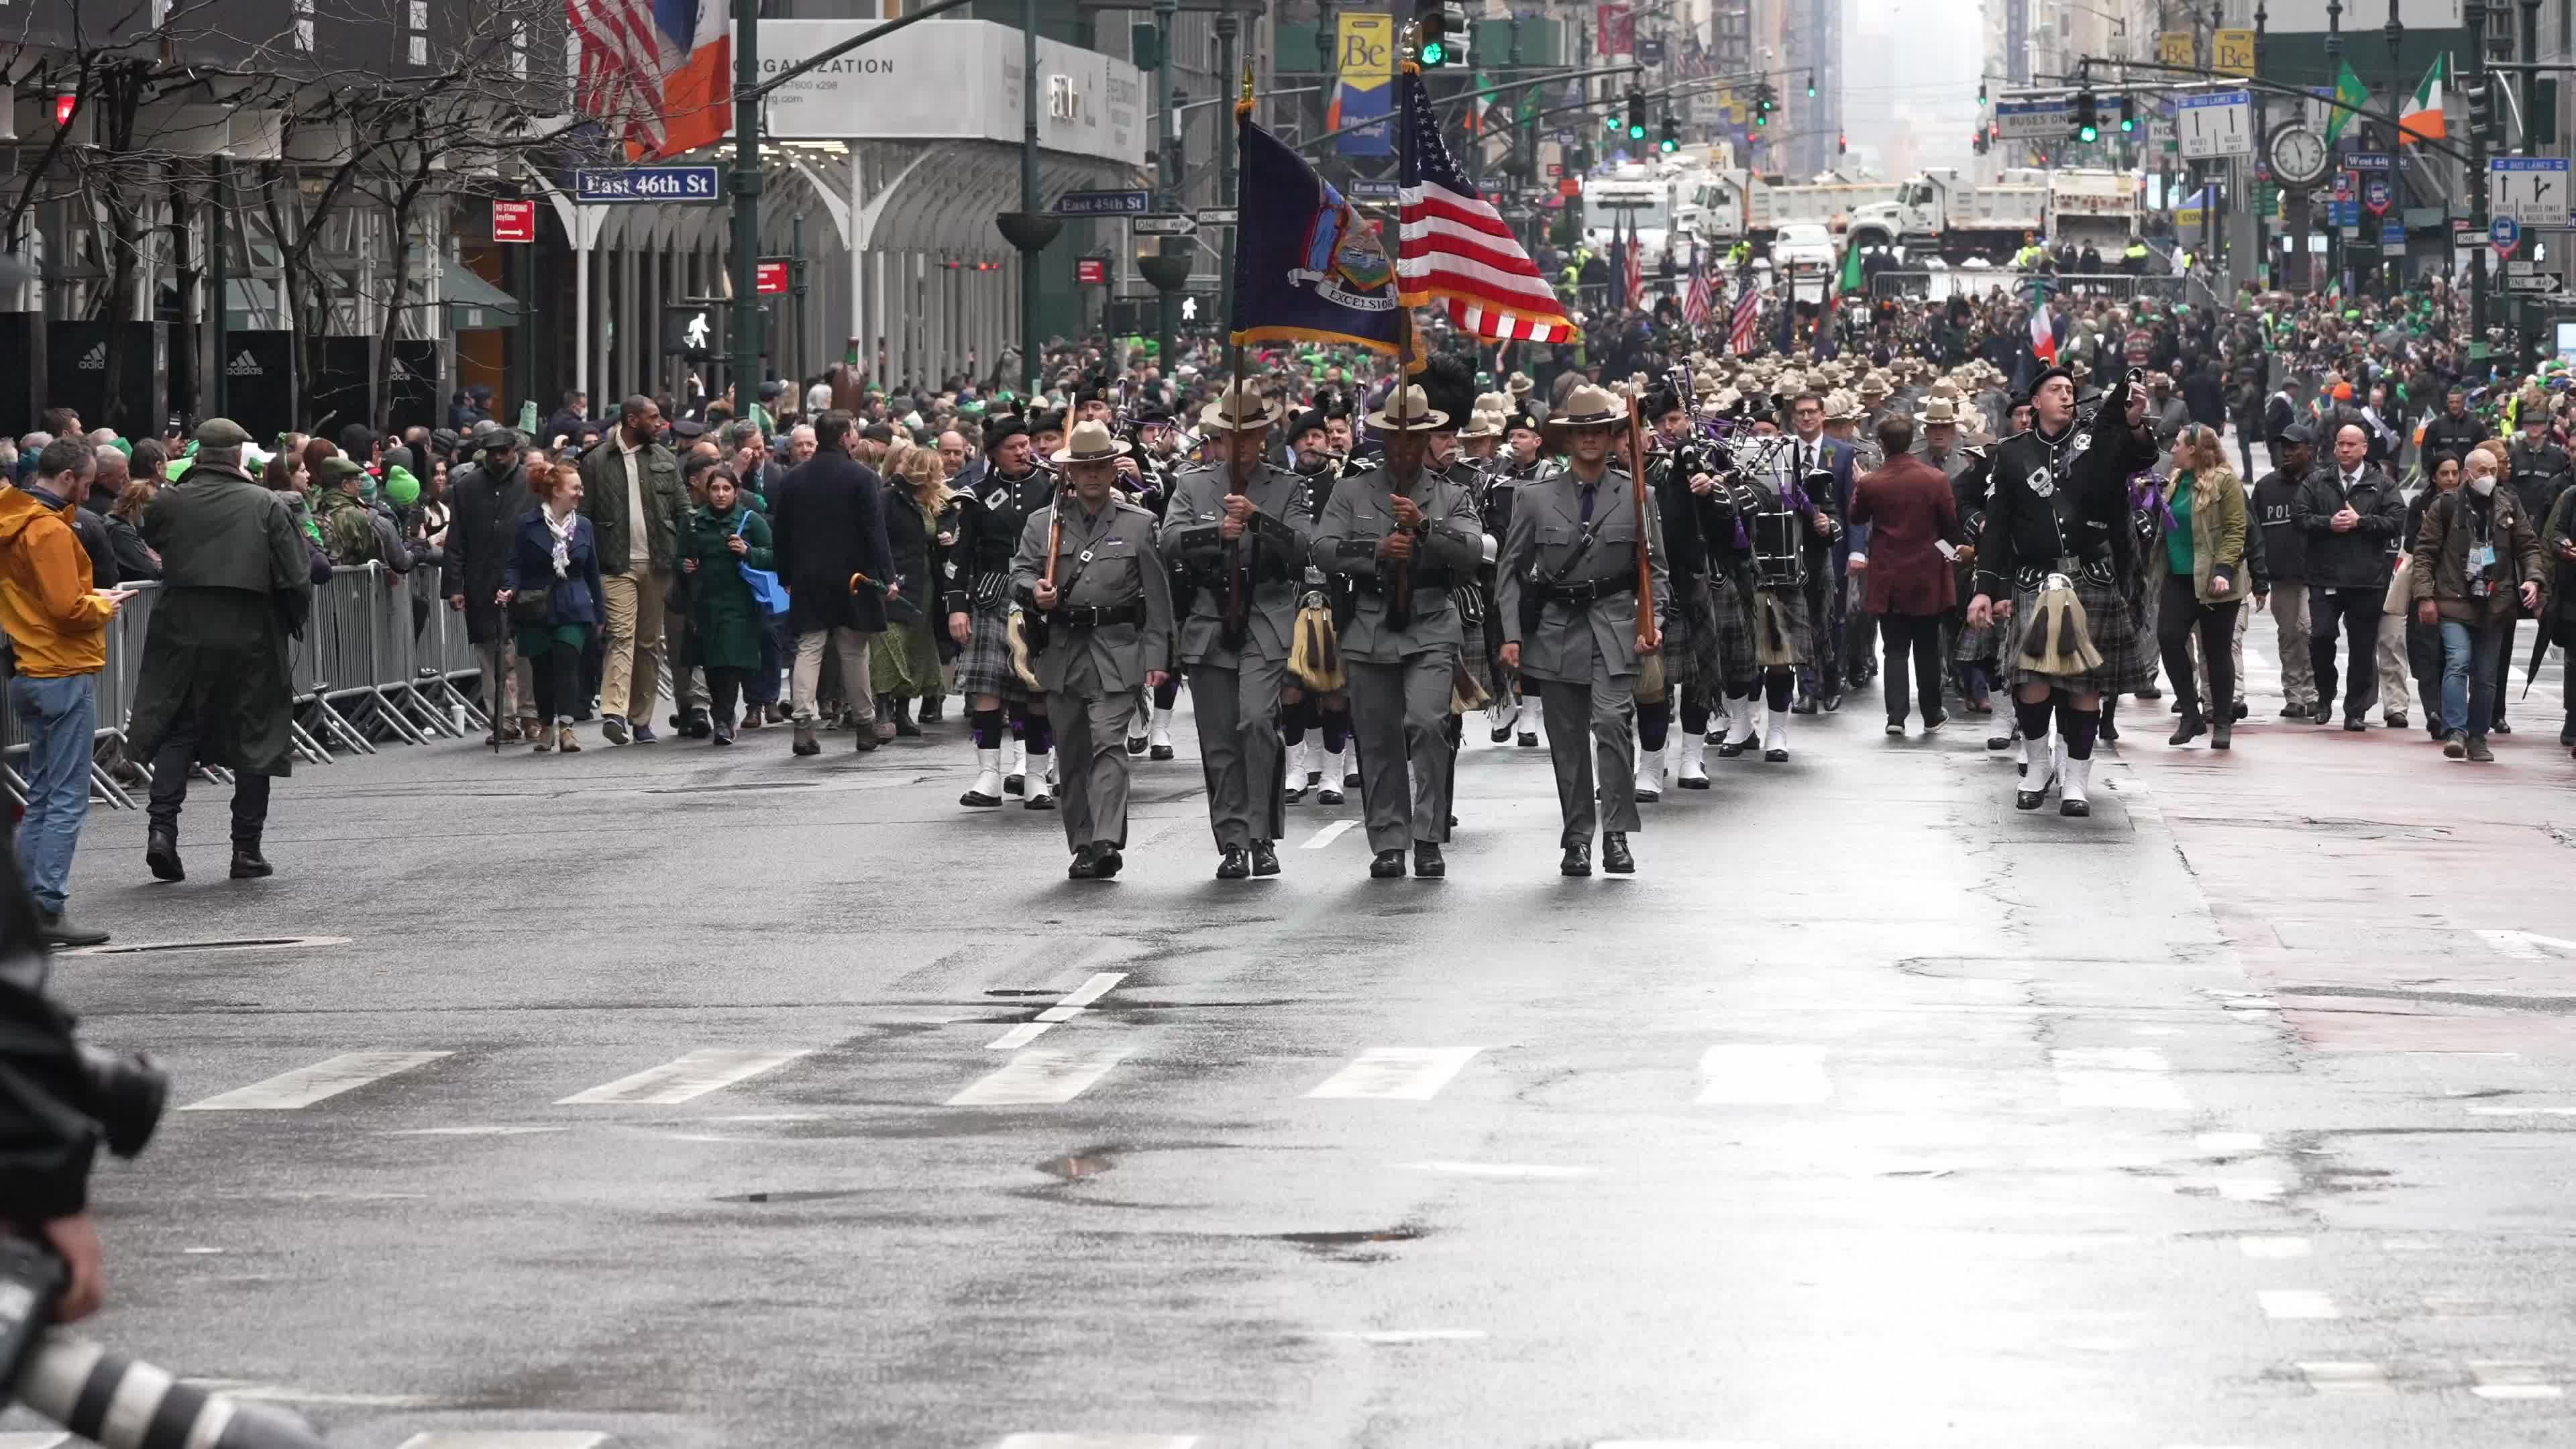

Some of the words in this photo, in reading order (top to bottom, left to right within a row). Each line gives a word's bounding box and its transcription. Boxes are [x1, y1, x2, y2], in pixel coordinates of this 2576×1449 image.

[1344, 35, 1385, 68] Be
[2009, 113, 2045, 125] BUSES
[2051, 113, 2069, 125] ON
[2349, 156, 2371, 165] West
[586, 176, 630, 193] East
[635, 175, 680, 193] 46th
[686, 174, 708, 193] St
[1063, 199, 1091, 211] East
[1094, 197, 1122, 210] 45th
[1126, 197, 1140, 209] St
[1137, 220, 1159, 230] ONE
[1169, 220, 1191, 230] WAY
[2459, 233, 2475, 242] ONE
[2535, 278, 2553, 287] WAY
[1330, 289, 1394, 309] EXCELSIOR
[226, 366, 263, 375] adidas
[2267, 504, 2292, 520] POL
